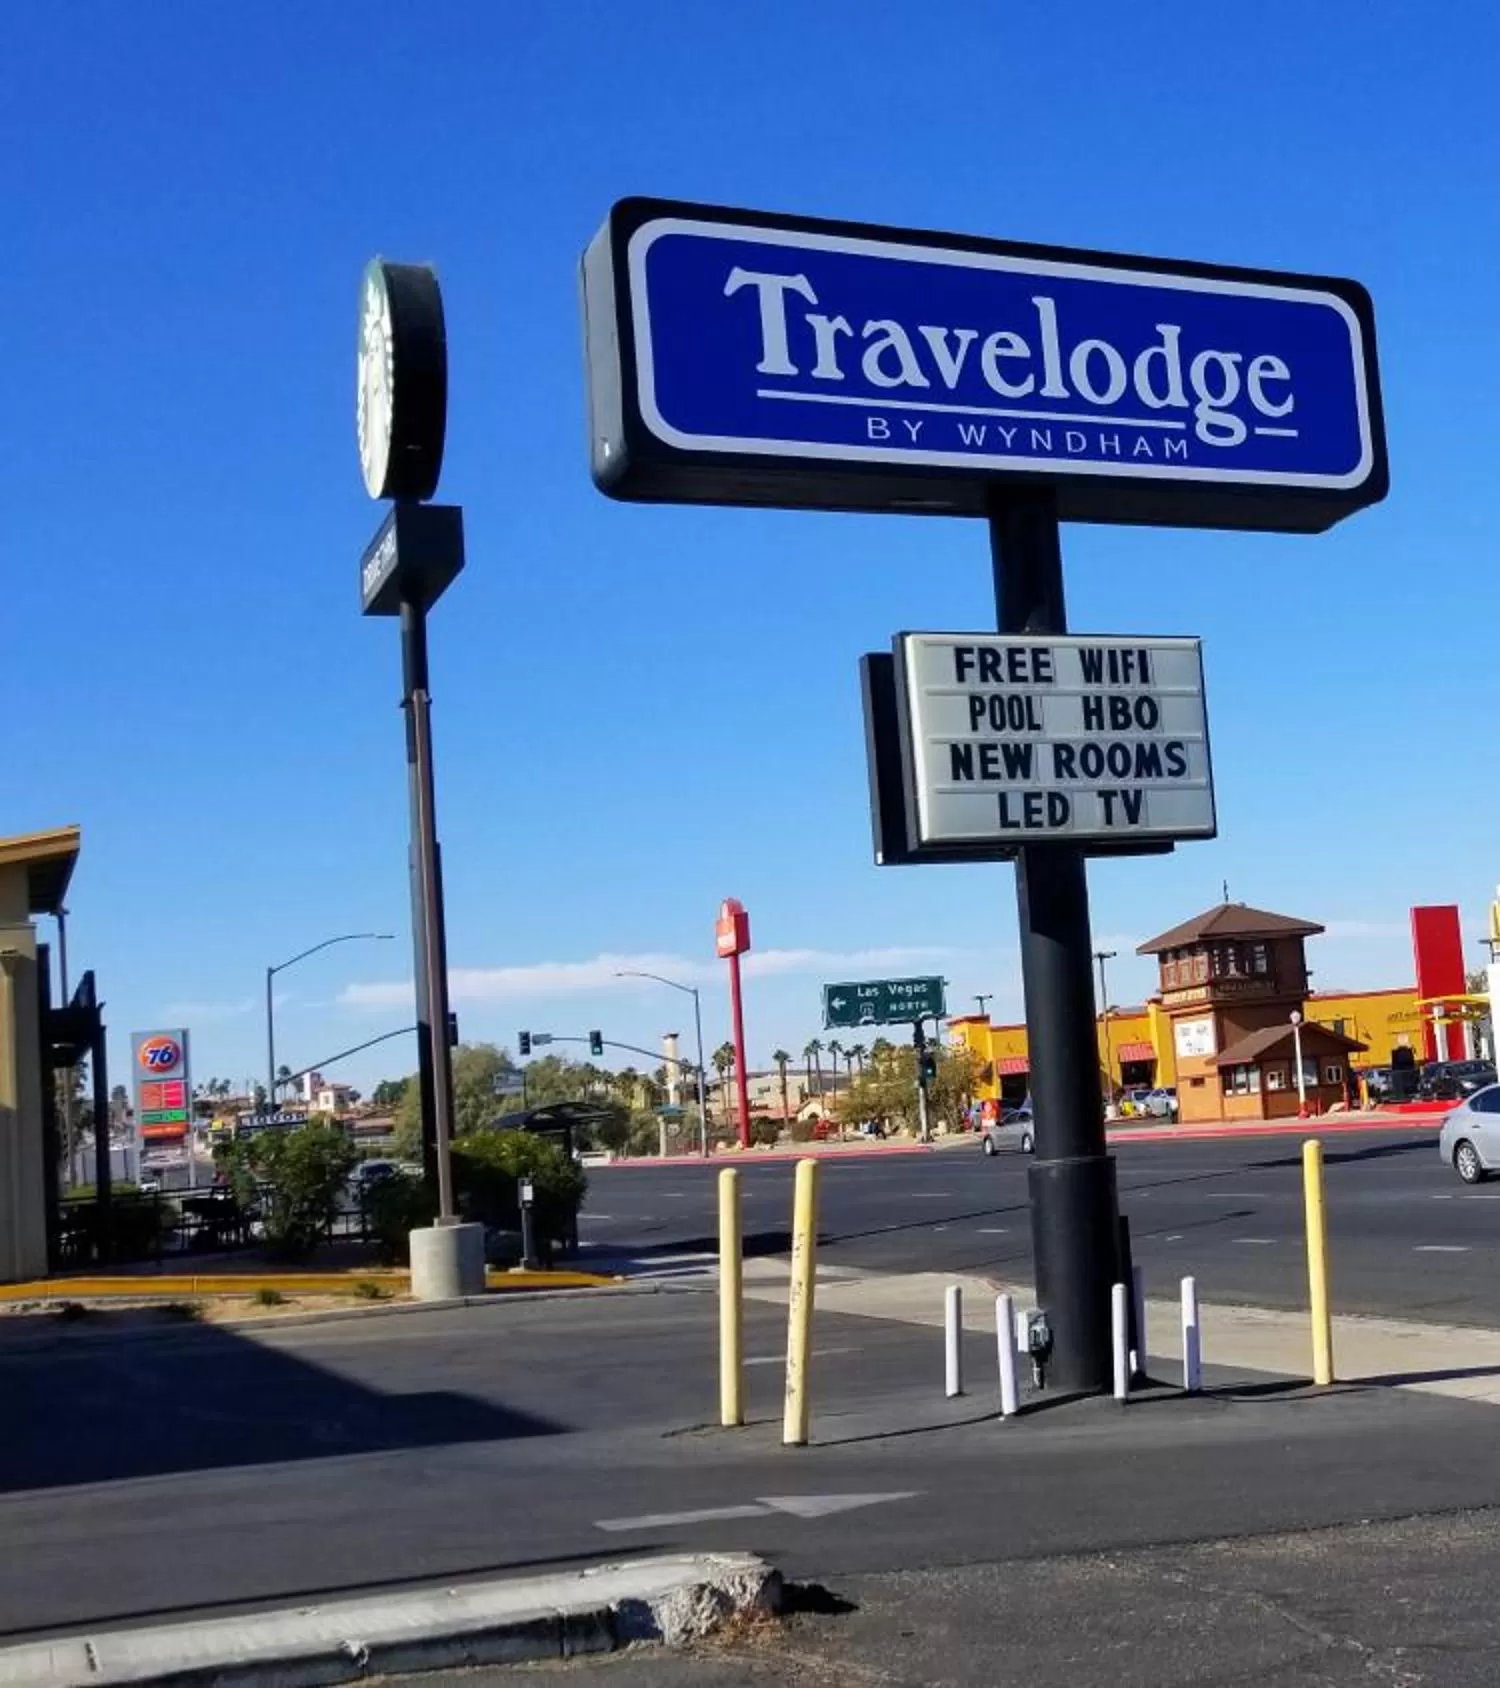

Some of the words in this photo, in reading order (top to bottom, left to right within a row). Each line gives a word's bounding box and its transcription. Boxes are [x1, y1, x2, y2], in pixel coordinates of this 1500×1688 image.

[724, 266, 1296, 447] Travelodge
[867, 416, 924, 443] BY
[959, 423, 1190, 460] WYNDHAM
[954, 647, 1054, 684] FREE
[1079, 648, 1151, 685] WIFI
[969, 694, 1041, 732] POOL
[1082, 695, 1159, 731] HBO
[951, 743, 1033, 781] NEW
[1053, 741, 1187, 780] ROOMS
[998, 791, 1071, 829] LED
[1097, 789, 1143, 826] TV
[857, 984, 880, 998] Las
[888, 981, 929, 997] Vegas
[147, 1045, 173, 1066] 76
